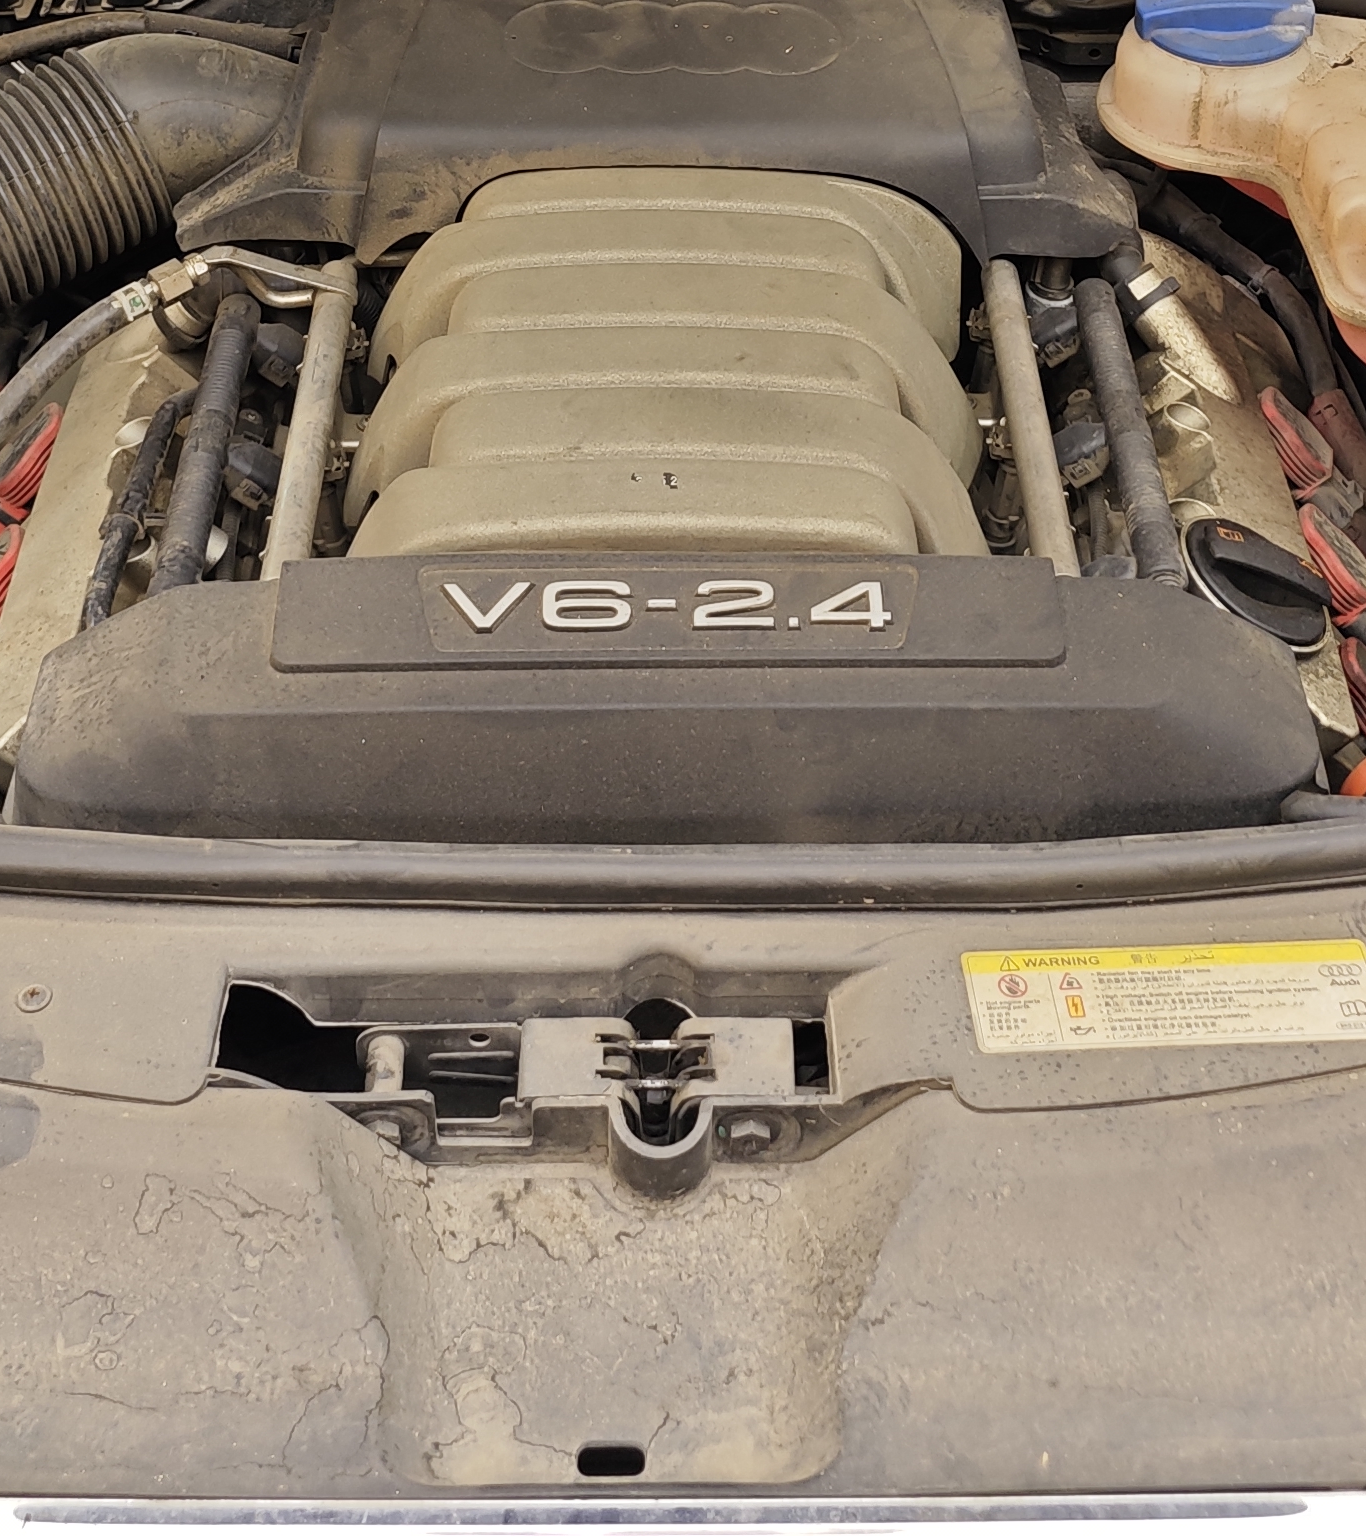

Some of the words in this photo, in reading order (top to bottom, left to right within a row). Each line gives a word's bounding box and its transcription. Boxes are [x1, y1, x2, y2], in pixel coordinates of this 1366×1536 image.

[441, 579, 894, 633] V6-2.4
[1022, 955, 1100, 968] WARNING
[1330, 978, 1360, 986] Audi
